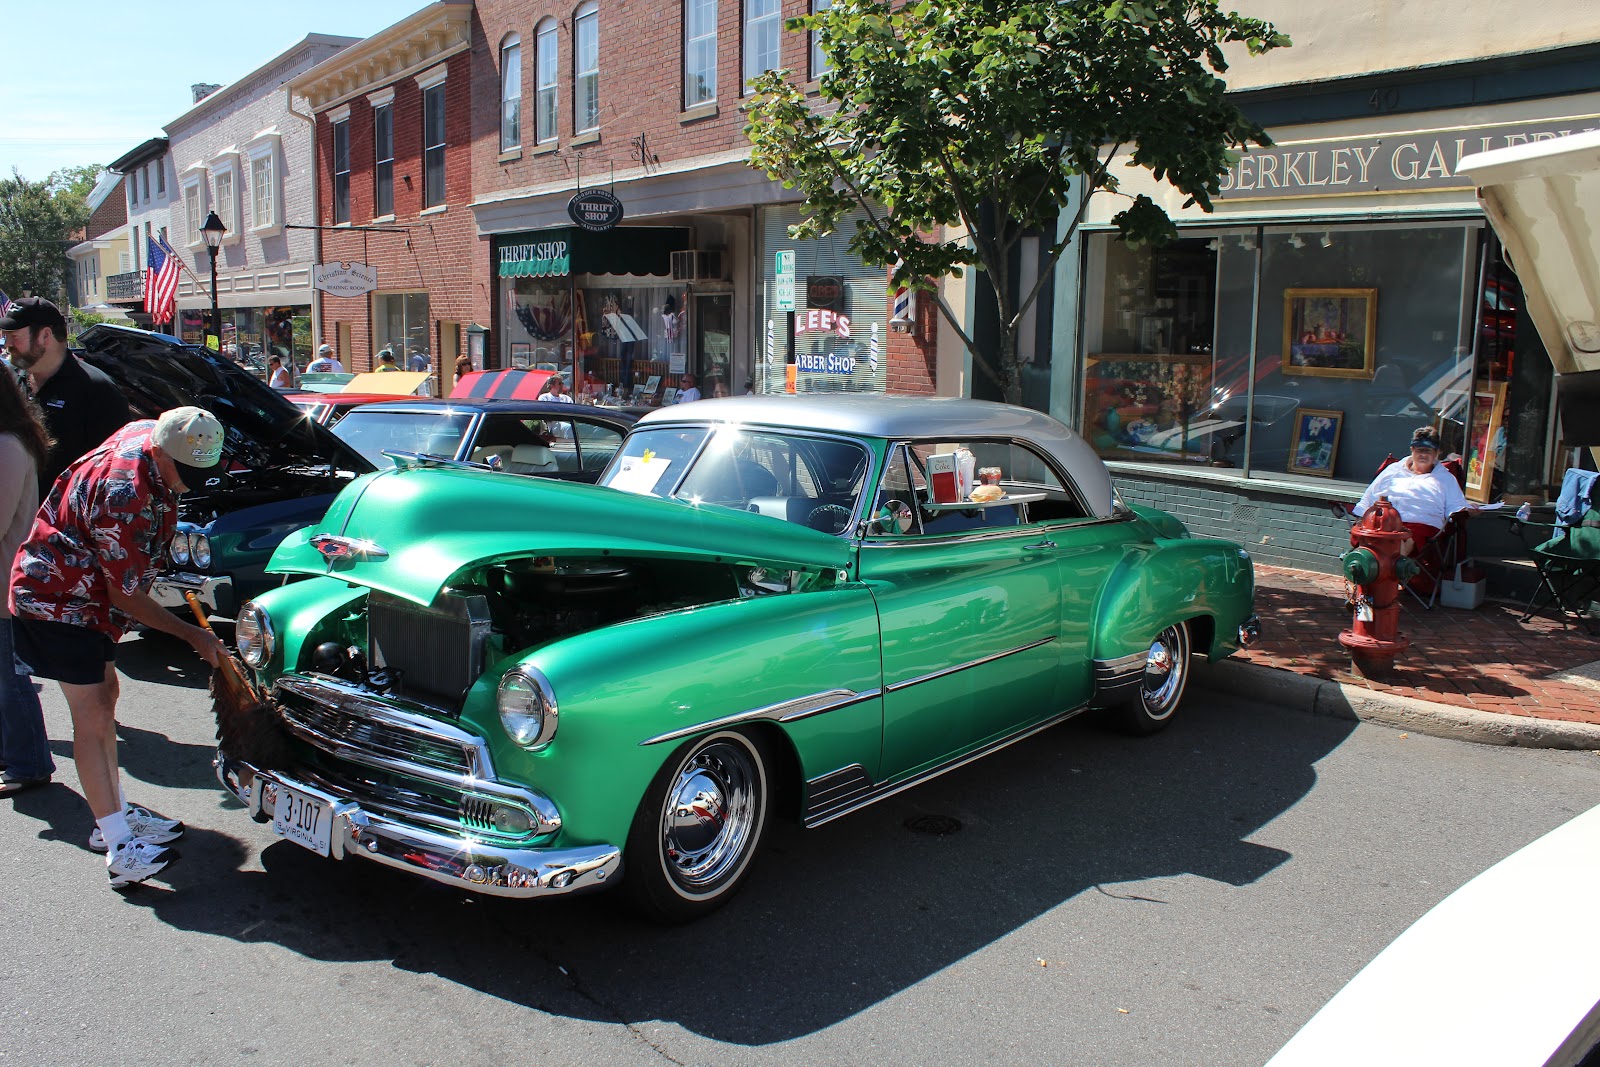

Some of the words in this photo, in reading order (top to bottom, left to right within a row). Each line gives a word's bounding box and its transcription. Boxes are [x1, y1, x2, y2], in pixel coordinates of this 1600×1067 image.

[1369, 89, 1400, 111] 40
[597, 190, 620, 206] HOSPITAL
[579, 202, 614, 212] THRIFT
[584, 212, 609, 221] SHOP
[499, 244, 535, 263] THRIFT
[537, 241, 566, 261] SHOP
[318, 269, 347, 282] Christian
[351, 269, 374, 283] Science
[795, 309, 850, 338] LEE'S
[795, 354, 825, 371] ARBER
[828, 353, 856, 372] SHOP
[286, 825, 312, 842] VIRGINIA
